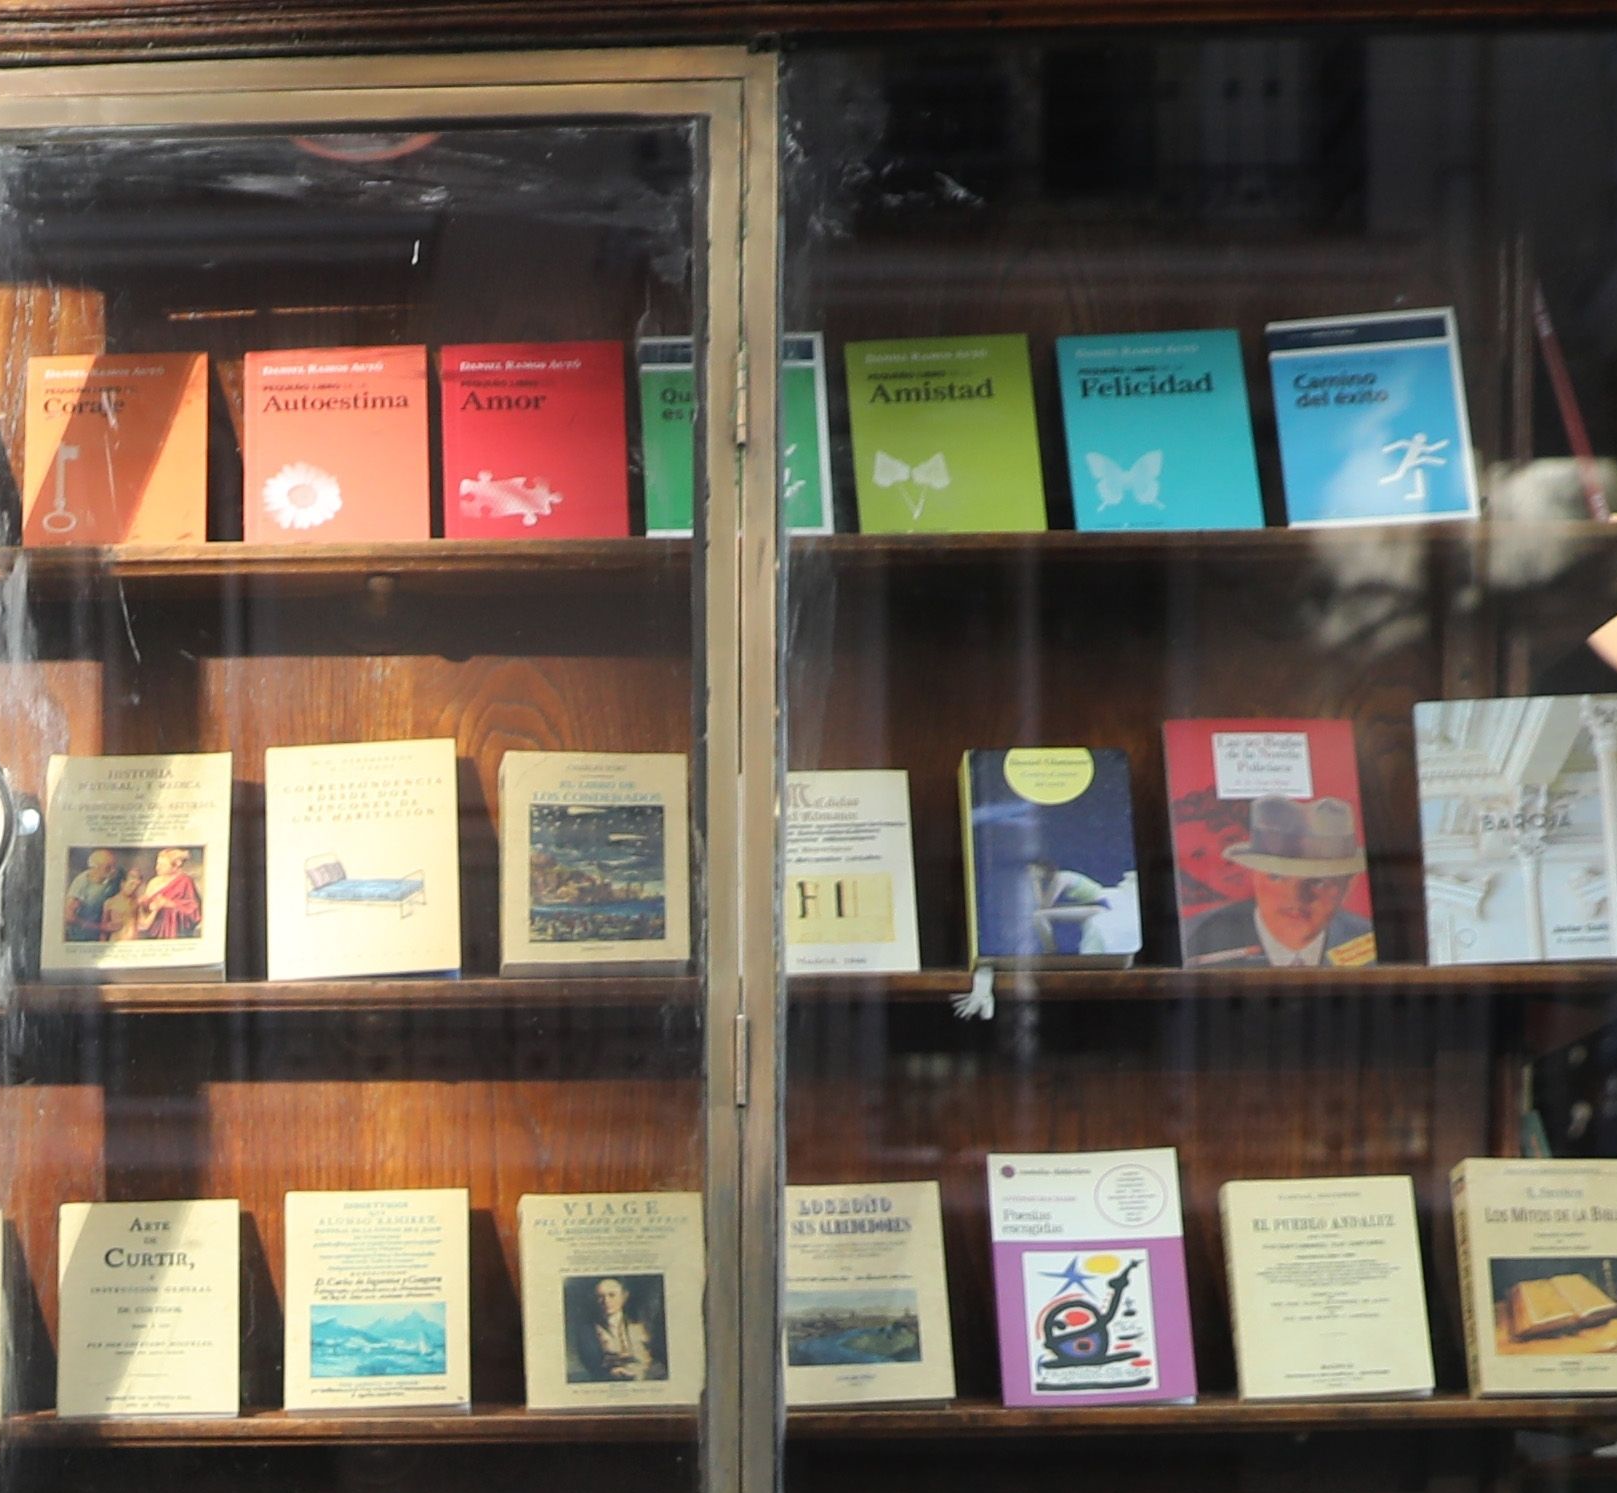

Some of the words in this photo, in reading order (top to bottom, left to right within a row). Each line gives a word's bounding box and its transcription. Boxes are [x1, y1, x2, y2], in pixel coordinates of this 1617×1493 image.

[870, 377, 994, 405] Amistad
[1079, 372, 1217, 399] Felicidad
[1292, 371, 1378, 391] Camino
[262, 392, 410, 413] Autoestima
[459, 391, 547, 412] Amor
[1294, 391, 1330, 409] del
[1332, 387, 1389, 406] éxito
[563, 1201, 661, 1216] VIAGE
[1252, 1217, 1270, 1232] EL
[1273, 1216, 1329, 1232] PUEBLO
[1330, 1213, 1395, 1230] ANDALUZ
